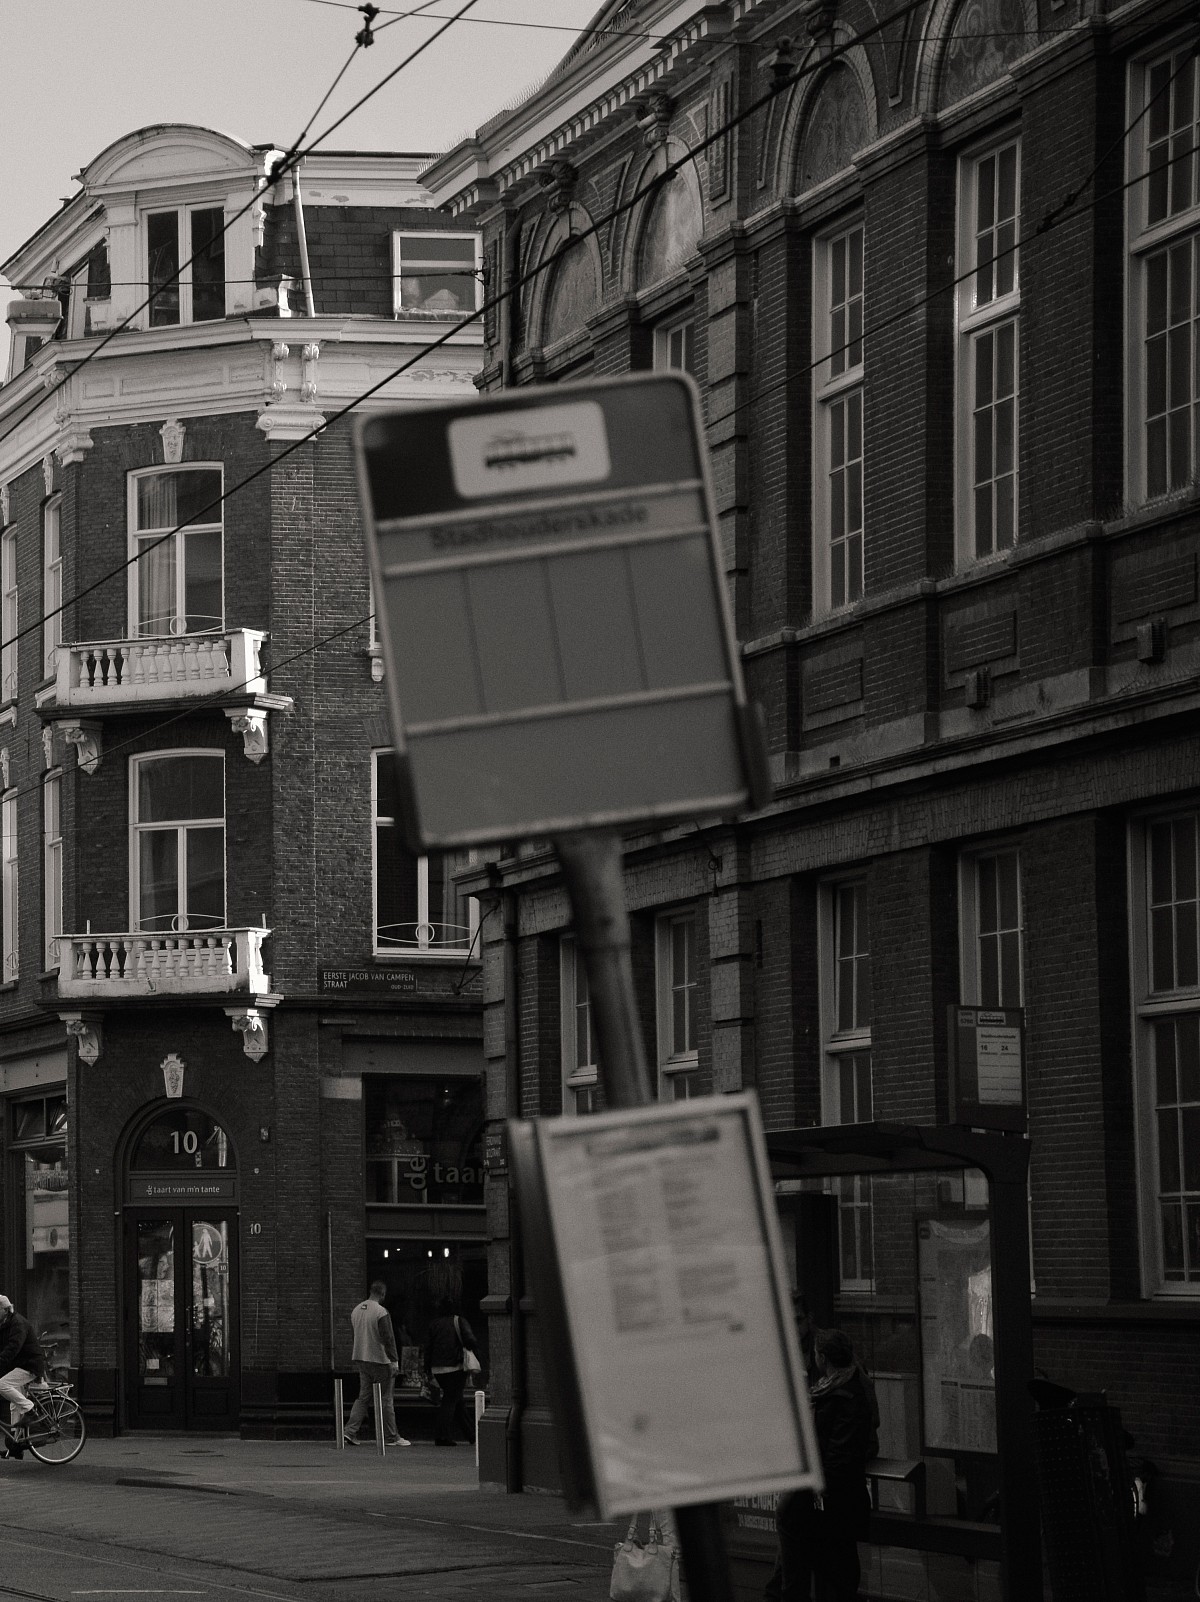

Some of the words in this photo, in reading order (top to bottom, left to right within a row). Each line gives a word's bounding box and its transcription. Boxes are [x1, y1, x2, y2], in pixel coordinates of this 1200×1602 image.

[323, 971, 347, 980] EERSTE
[349, 973, 369, 981] JACOB
[371, 973, 384, 981] VAN
[386, 973, 414, 981] CAMPEN
[323, 981, 348, 989] STRAAT
[170, 1130, 198, 1154] 10
[153, 1185, 171, 1193] taart
[201, 1185, 220, 1193] tante
[250, 1223, 262, 1234] 10
